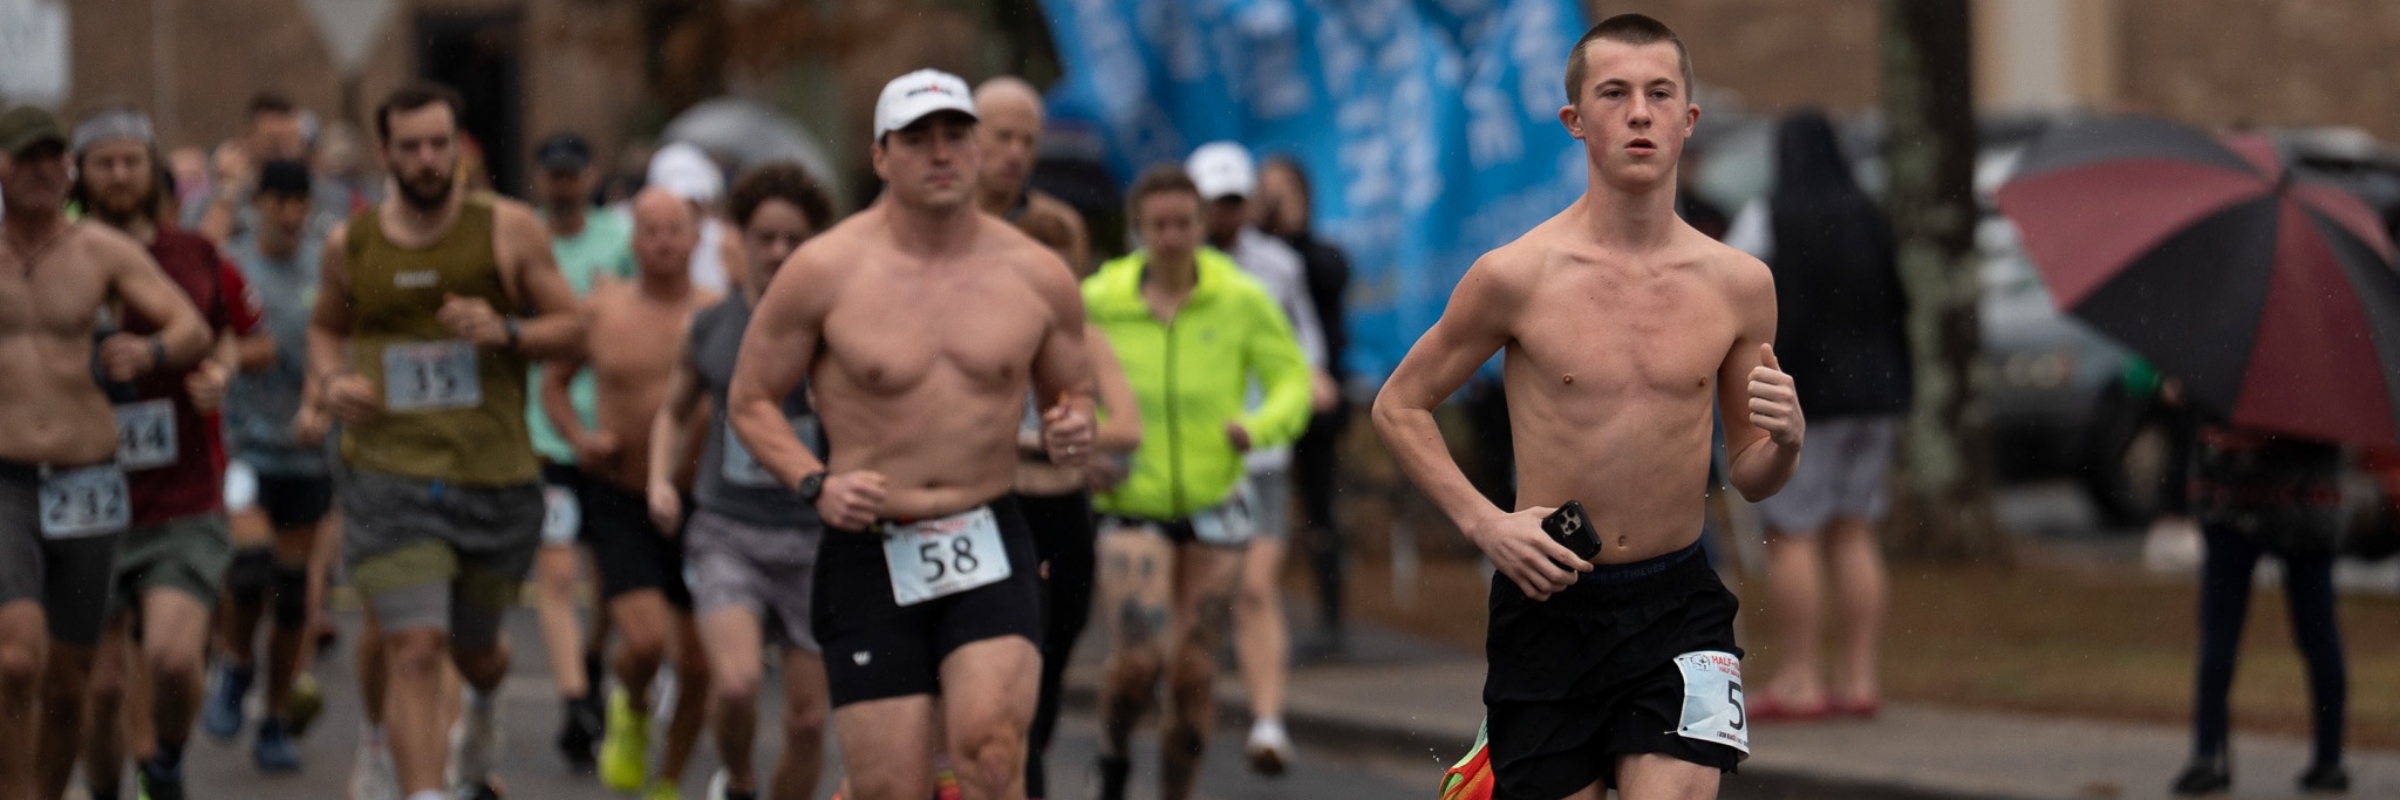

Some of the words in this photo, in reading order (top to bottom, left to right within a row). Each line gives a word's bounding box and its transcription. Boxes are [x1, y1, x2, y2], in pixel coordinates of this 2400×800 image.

[407, 358, 459, 399] 35
[47, 481, 126, 522] 232
[919, 535, 978, 583] 58
[1622, 561, 1667, 579] THIEVES
[1728, 680, 1744, 731] 5
